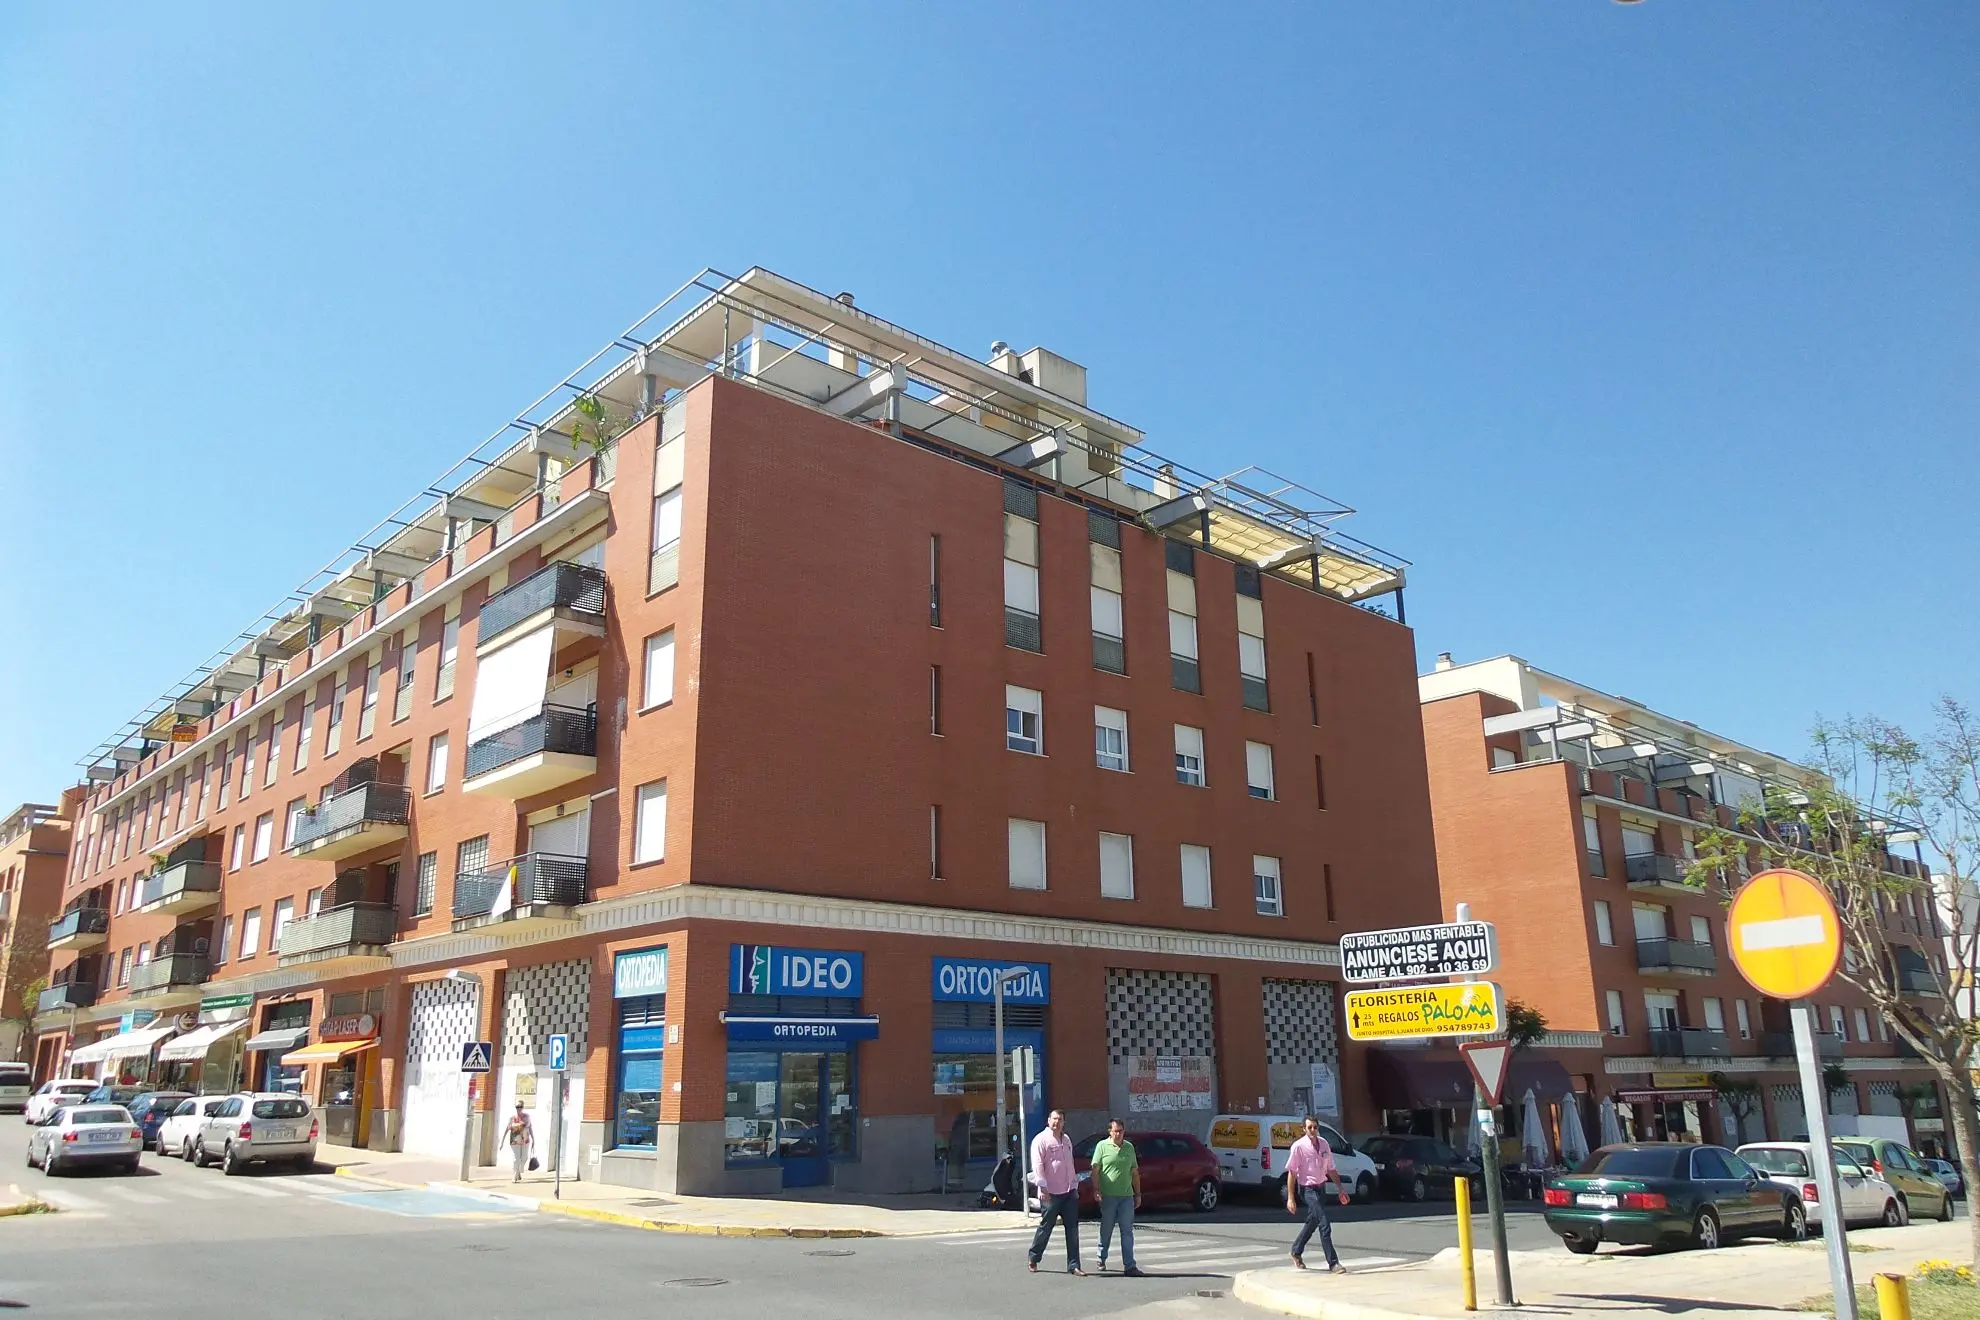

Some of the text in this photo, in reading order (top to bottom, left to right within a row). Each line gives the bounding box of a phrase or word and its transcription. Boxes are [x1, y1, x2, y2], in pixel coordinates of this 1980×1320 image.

[1344, 924, 1484, 949] SU PUBLICIDAD MAS RENTABLE
[1346, 938, 1486, 968] ANUNCIESE AQUI
[618, 953, 665, 992] ORTOPEDIA
[782, 955, 852, 990] IDEO
[1347, 966, 1386, 980] LLAME
[1389, 965, 1404, 977] AL
[1406, 963, 1427, 975] 902
[1437, 961, 1451, 973] 10
[1454, 960, 1469, 972] 36
[1472, 959, 1487, 970] 69
[1350, 991, 1437, 1007] FLORISTERÍA
[1378, 1010, 1419, 1024] REGALOS
[1422, 999, 1493, 1025] PALOMA
[774, 1025, 837, 1037] ORTOPEDIA
[1356, 1029, 1372, 1037] JUNTO
[1372, 1028, 1396, 1037] HOSPITAL
[1436, 1022, 1491, 1033] 954789743
[552, 1038, 563, 1067] P
